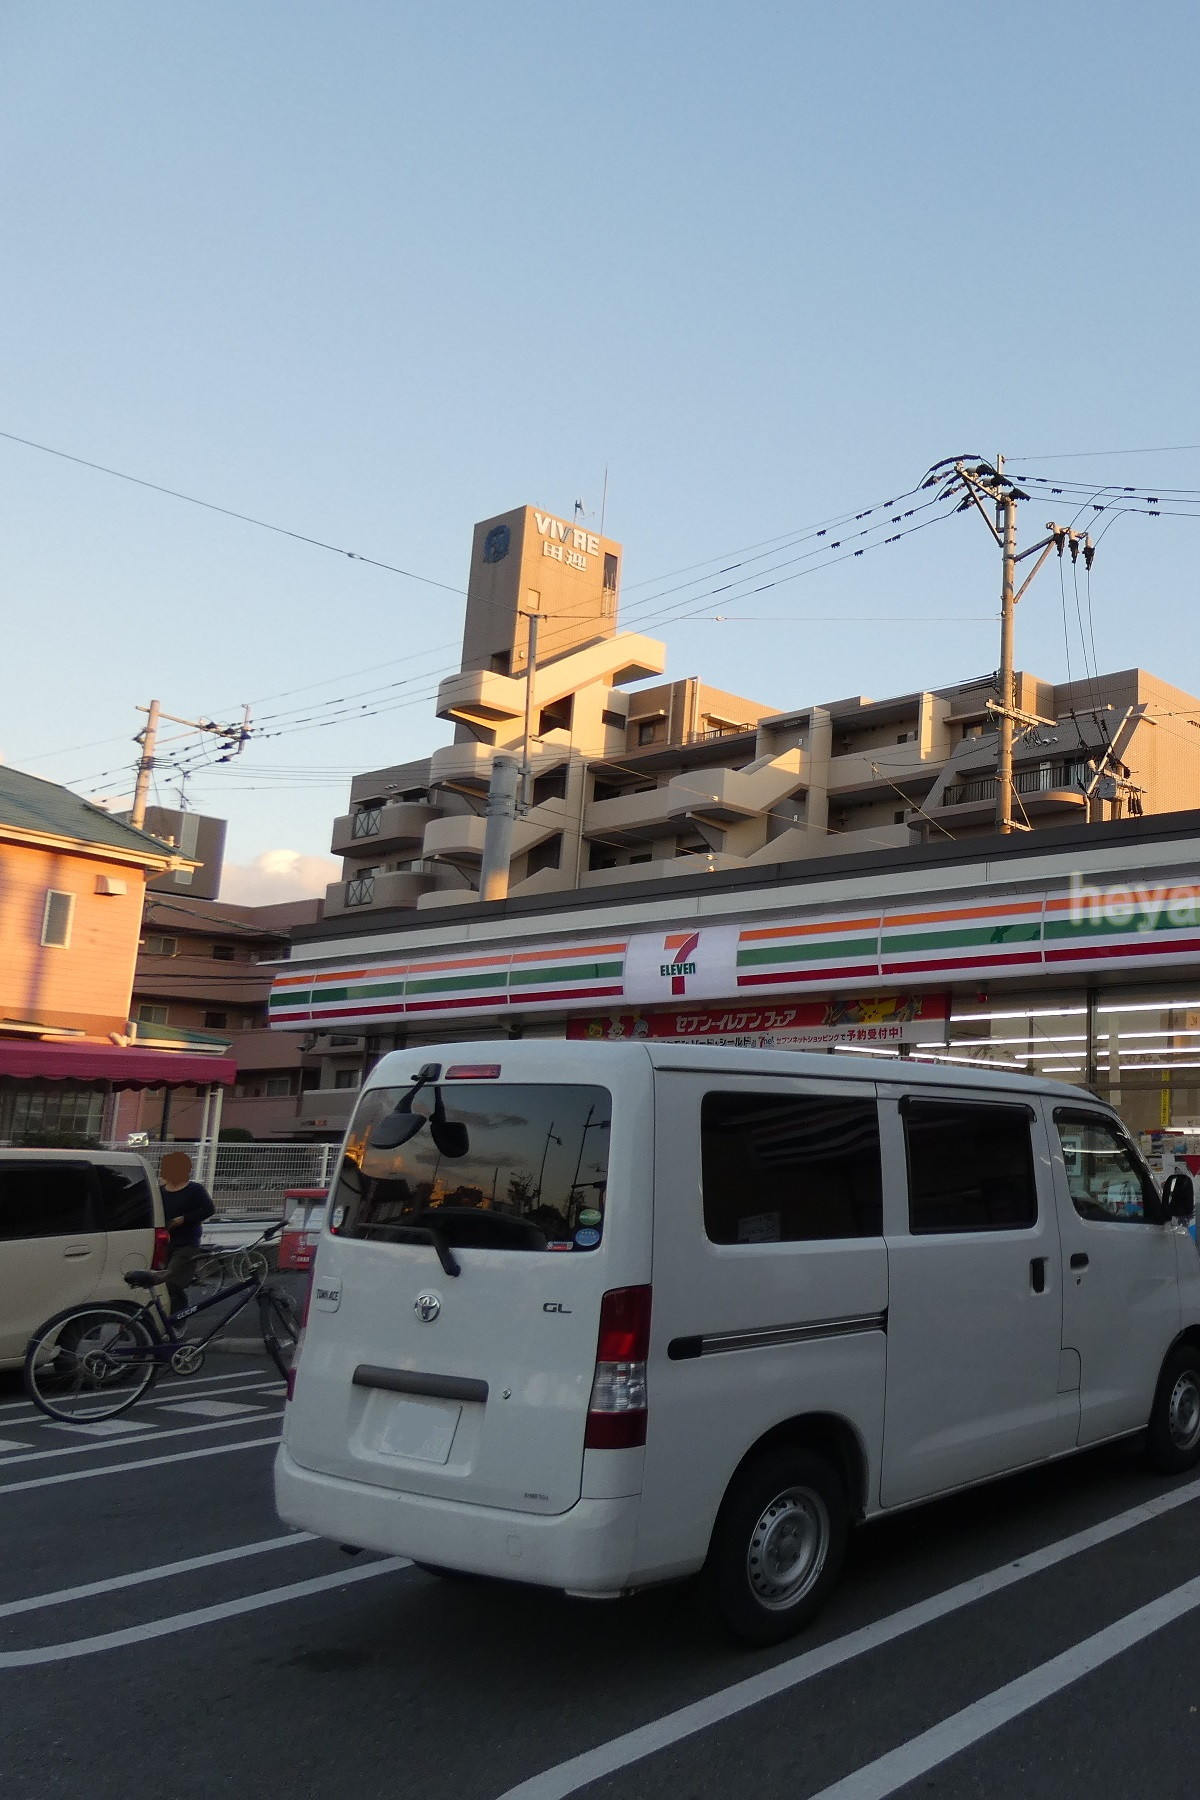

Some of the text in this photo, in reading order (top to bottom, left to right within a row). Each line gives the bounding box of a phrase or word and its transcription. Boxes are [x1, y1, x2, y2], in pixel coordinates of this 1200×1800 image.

[534, 512, 599, 557] VIVRE
[543, 541, 587, 572] 田迎
[542, 1302, 572, 1314] GL
